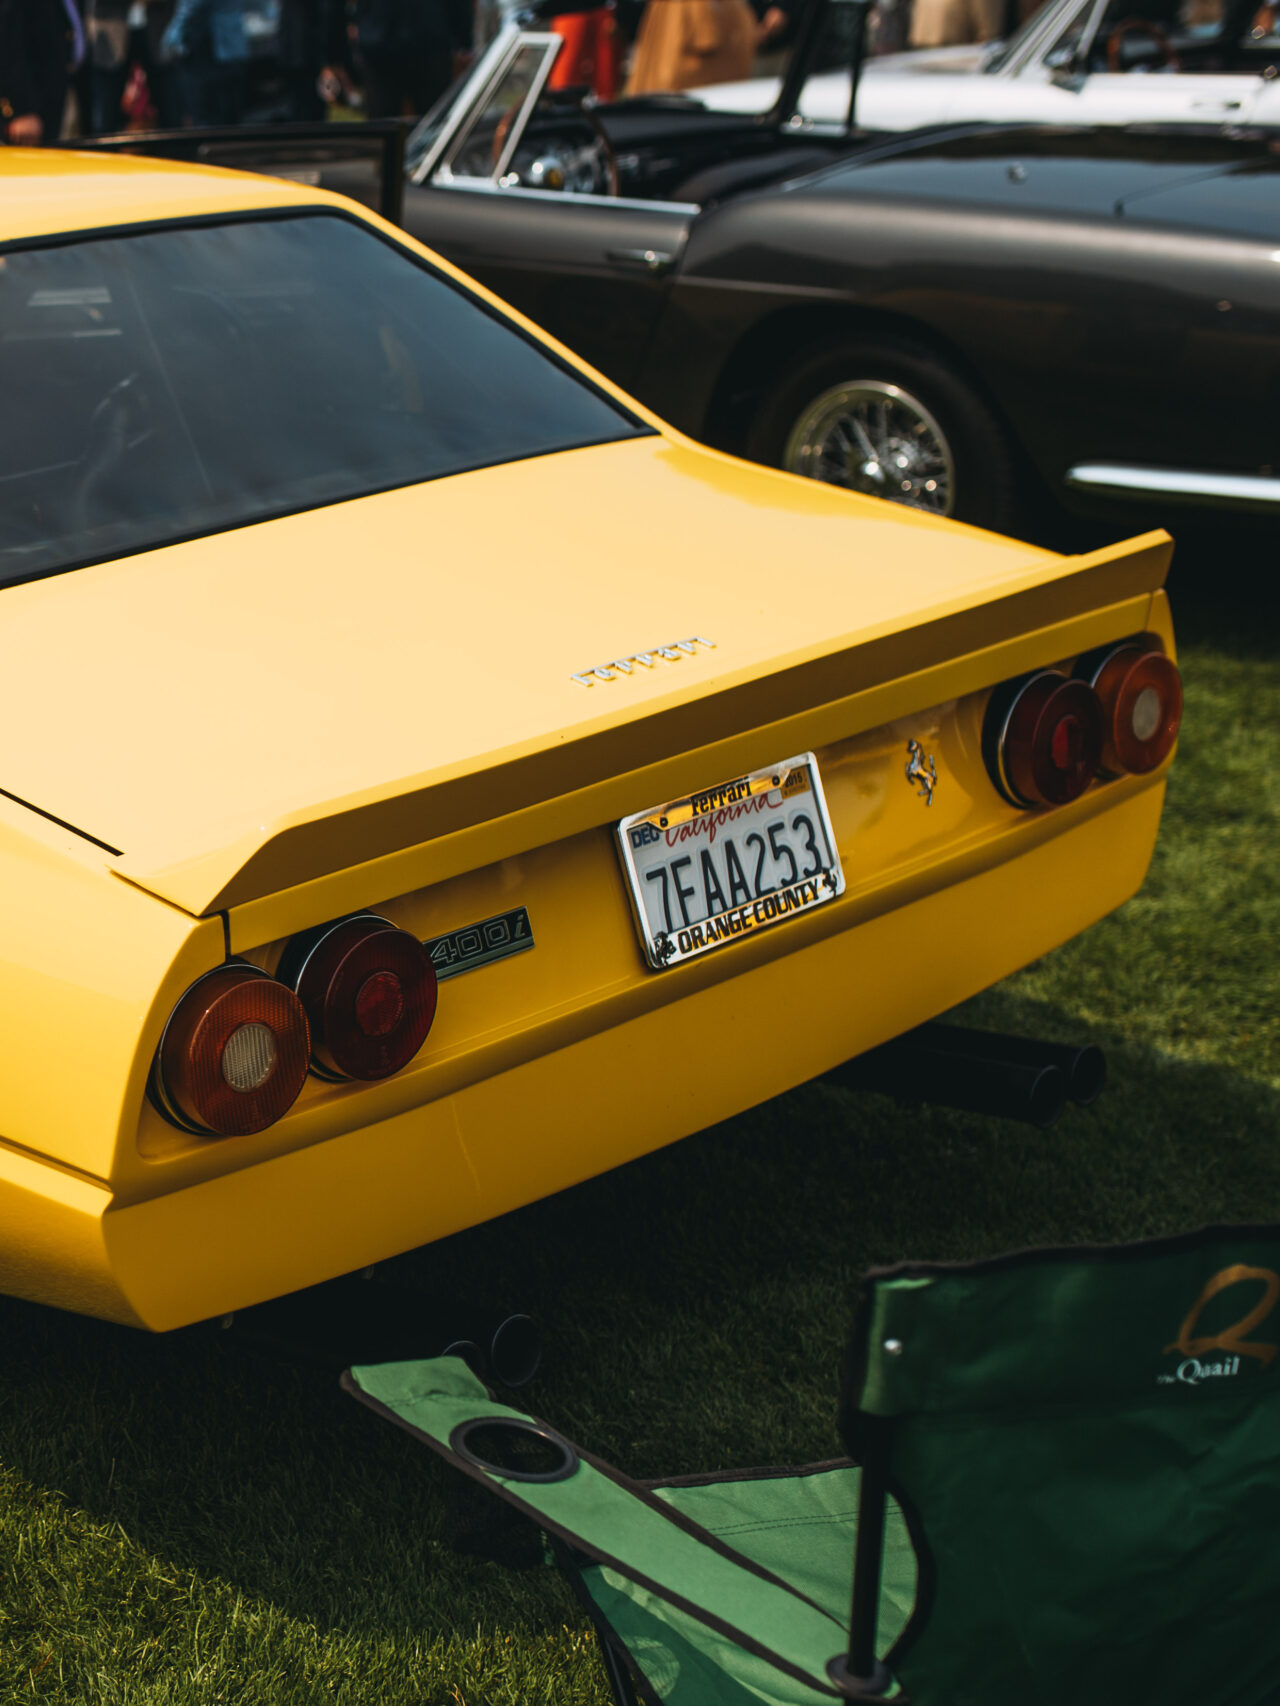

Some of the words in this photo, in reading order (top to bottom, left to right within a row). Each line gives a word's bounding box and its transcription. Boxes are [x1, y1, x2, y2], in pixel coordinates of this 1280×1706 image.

[665, 792, 784, 847] California
[690, 776, 752, 817] Ferrari
[631, 826, 660, 849] DEC
[646, 814, 821, 934] 7FAA253
[430, 914, 525, 964] 400i
[677, 907, 752, 954] ORANGE
[753, 878, 820, 923] COUNTY
[1177, 1355, 1239, 1385] Quail
